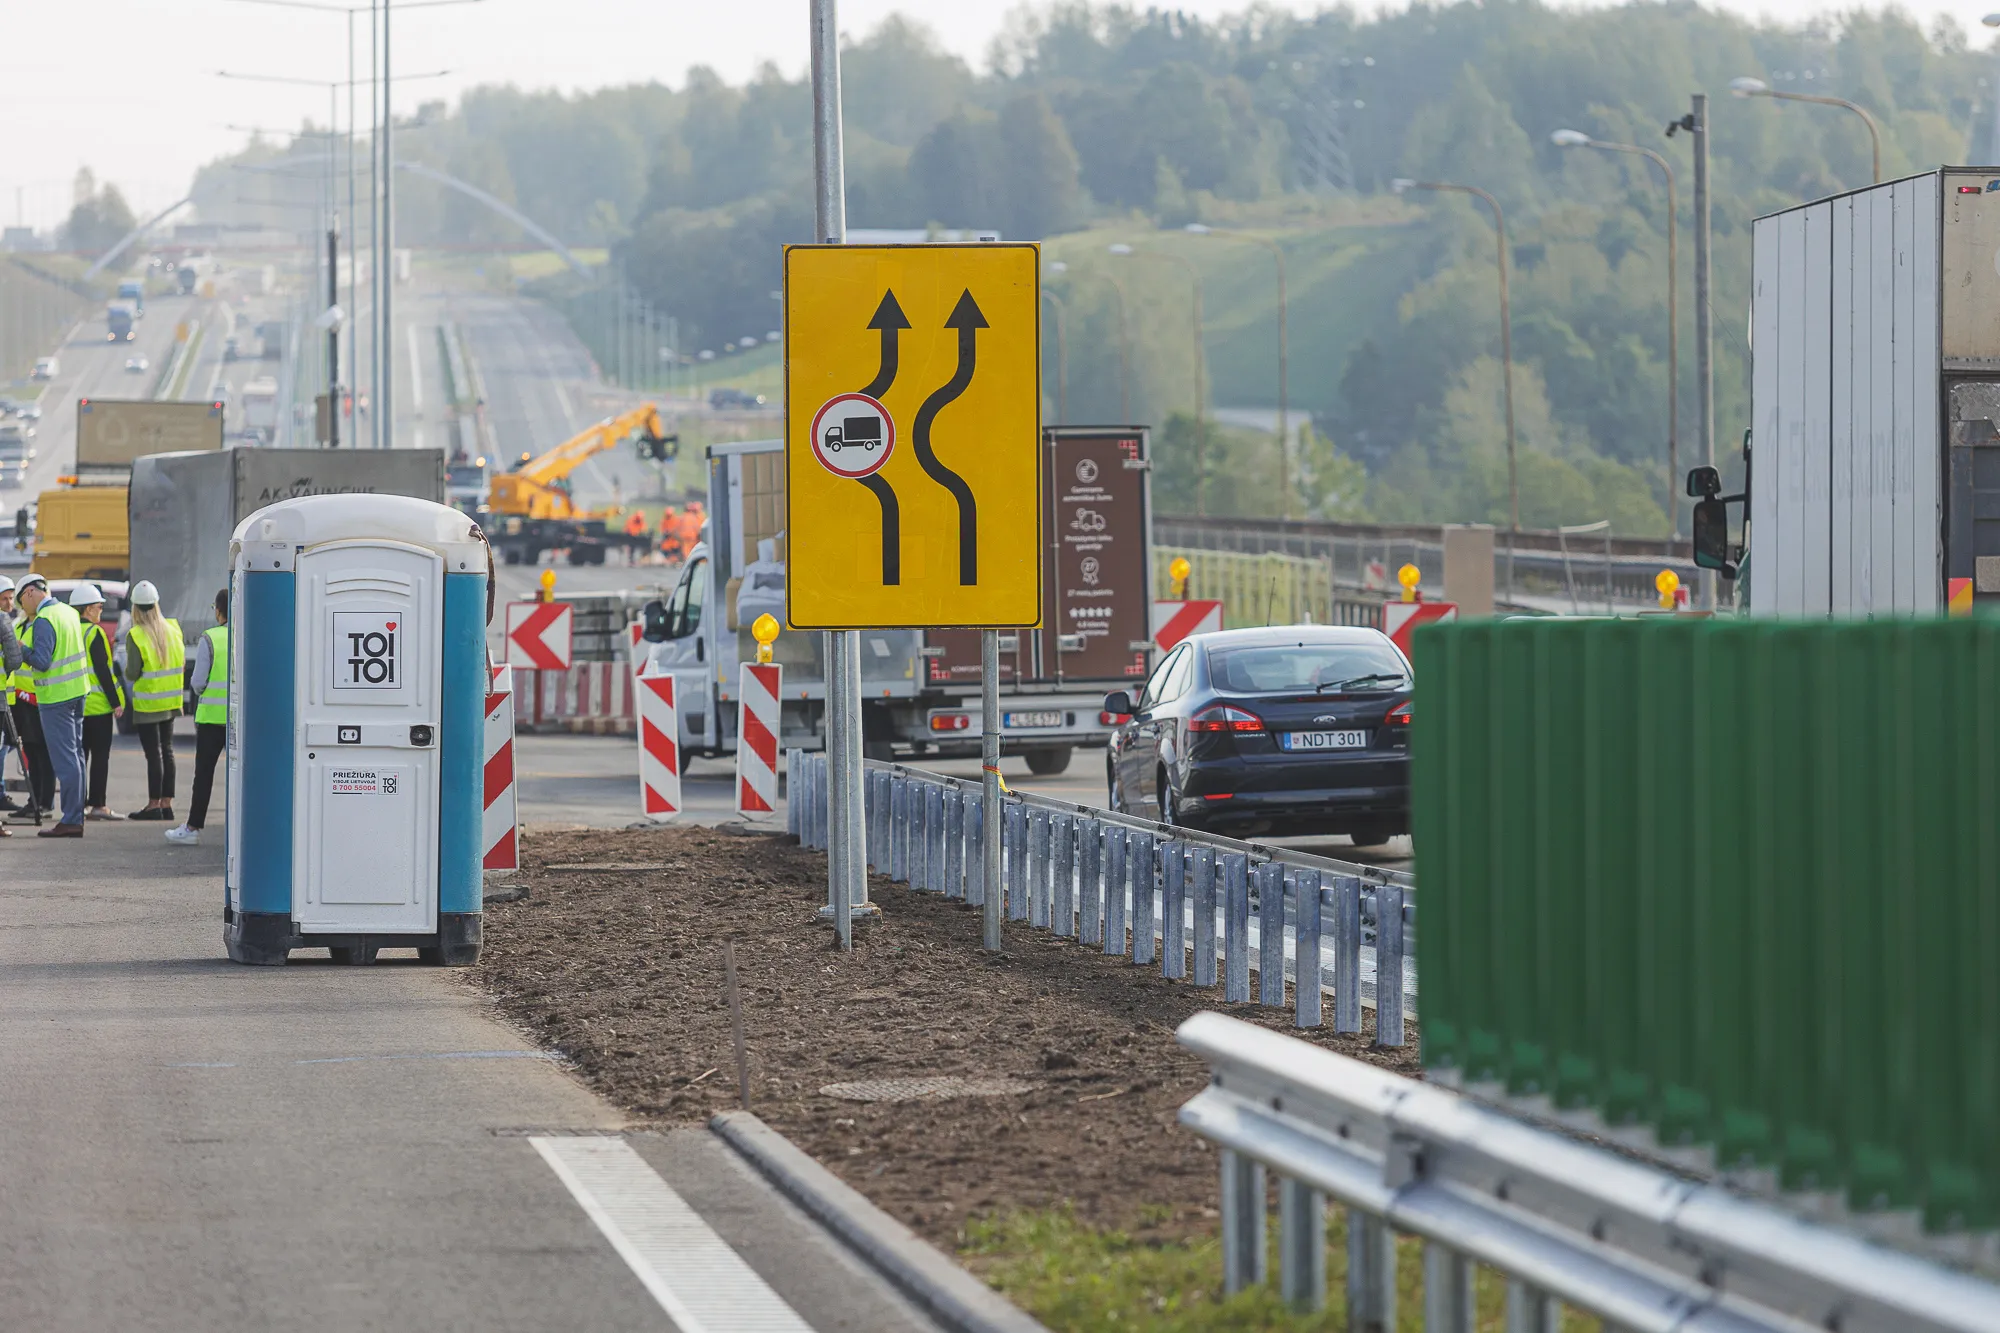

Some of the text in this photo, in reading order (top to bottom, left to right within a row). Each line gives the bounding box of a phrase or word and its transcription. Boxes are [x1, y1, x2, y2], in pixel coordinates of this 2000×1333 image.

[348, 632, 394, 657] TOI
[348, 658, 394, 683] TOI
[1302, 733, 1334, 746] NDT
[1338, 732, 1361, 746] 301
